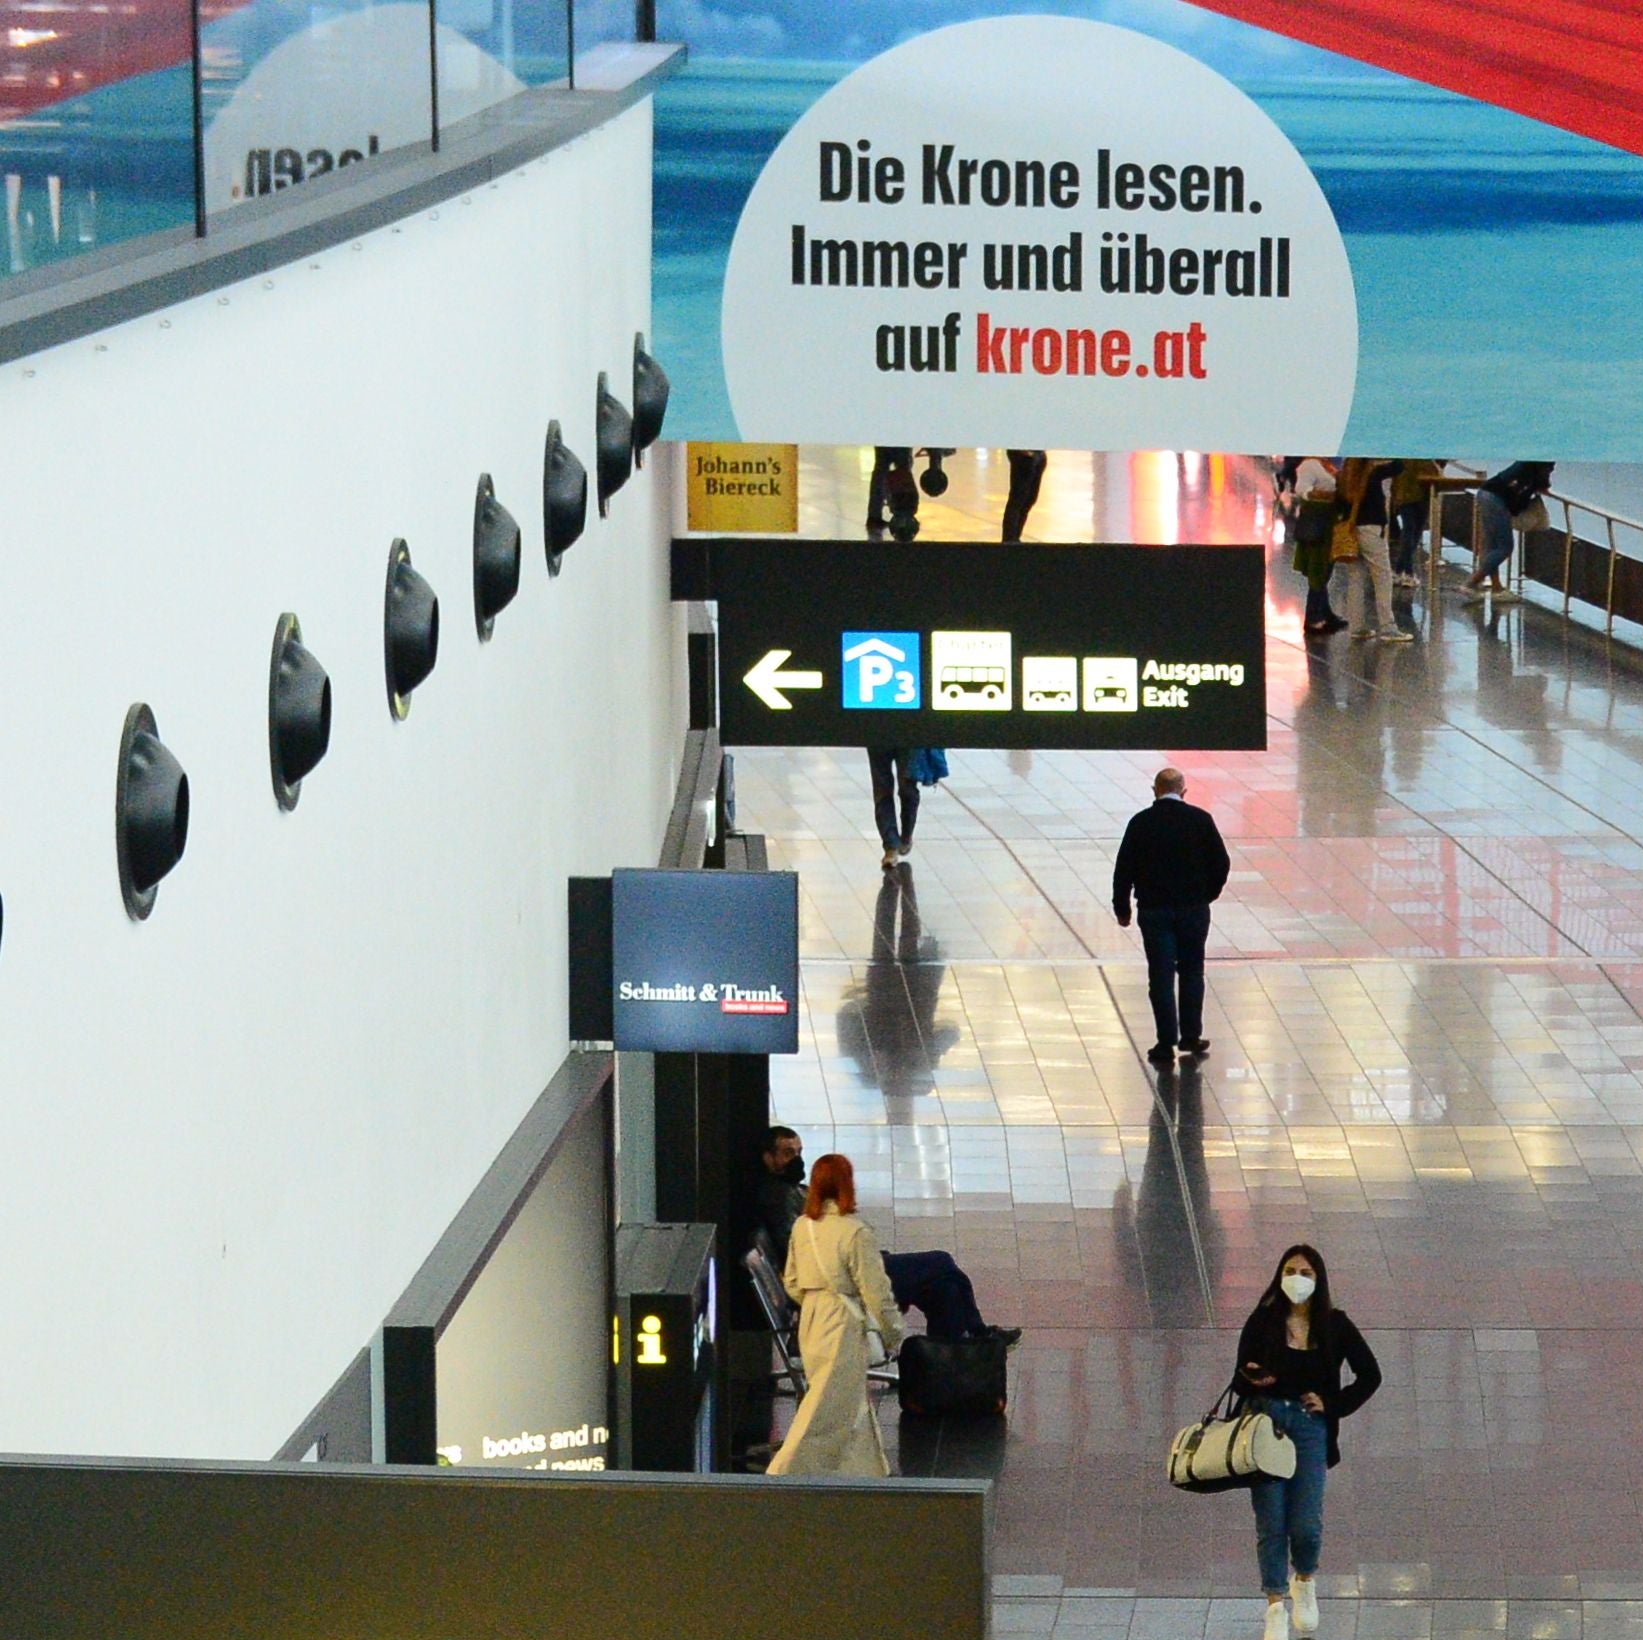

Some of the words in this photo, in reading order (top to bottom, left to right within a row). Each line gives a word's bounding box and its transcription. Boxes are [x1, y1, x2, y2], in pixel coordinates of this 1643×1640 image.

[819, 139, 905, 204] Die
[922, 143, 1081, 208] Krone
[1097, 148, 1263, 214] lesen.
[791, 224, 968, 289] Immer
[983, 231, 1083, 292] und
[1100, 231, 1291, 298] überall
[875, 312, 961, 373] auf
[976, 313, 1208, 380] krone.at
[705, 477, 782, 496] Biereck
[1141, 659, 1245, 686] Ausgang
[1142, 685, 1188, 708] Exit
[619, 982, 697, 1001] Schmitt
[699, 983, 718, 1001] &
[721, 984, 784, 1002] Trunk
[483, 1431, 546, 1459] books
[550, 1424, 588, 1450] and
